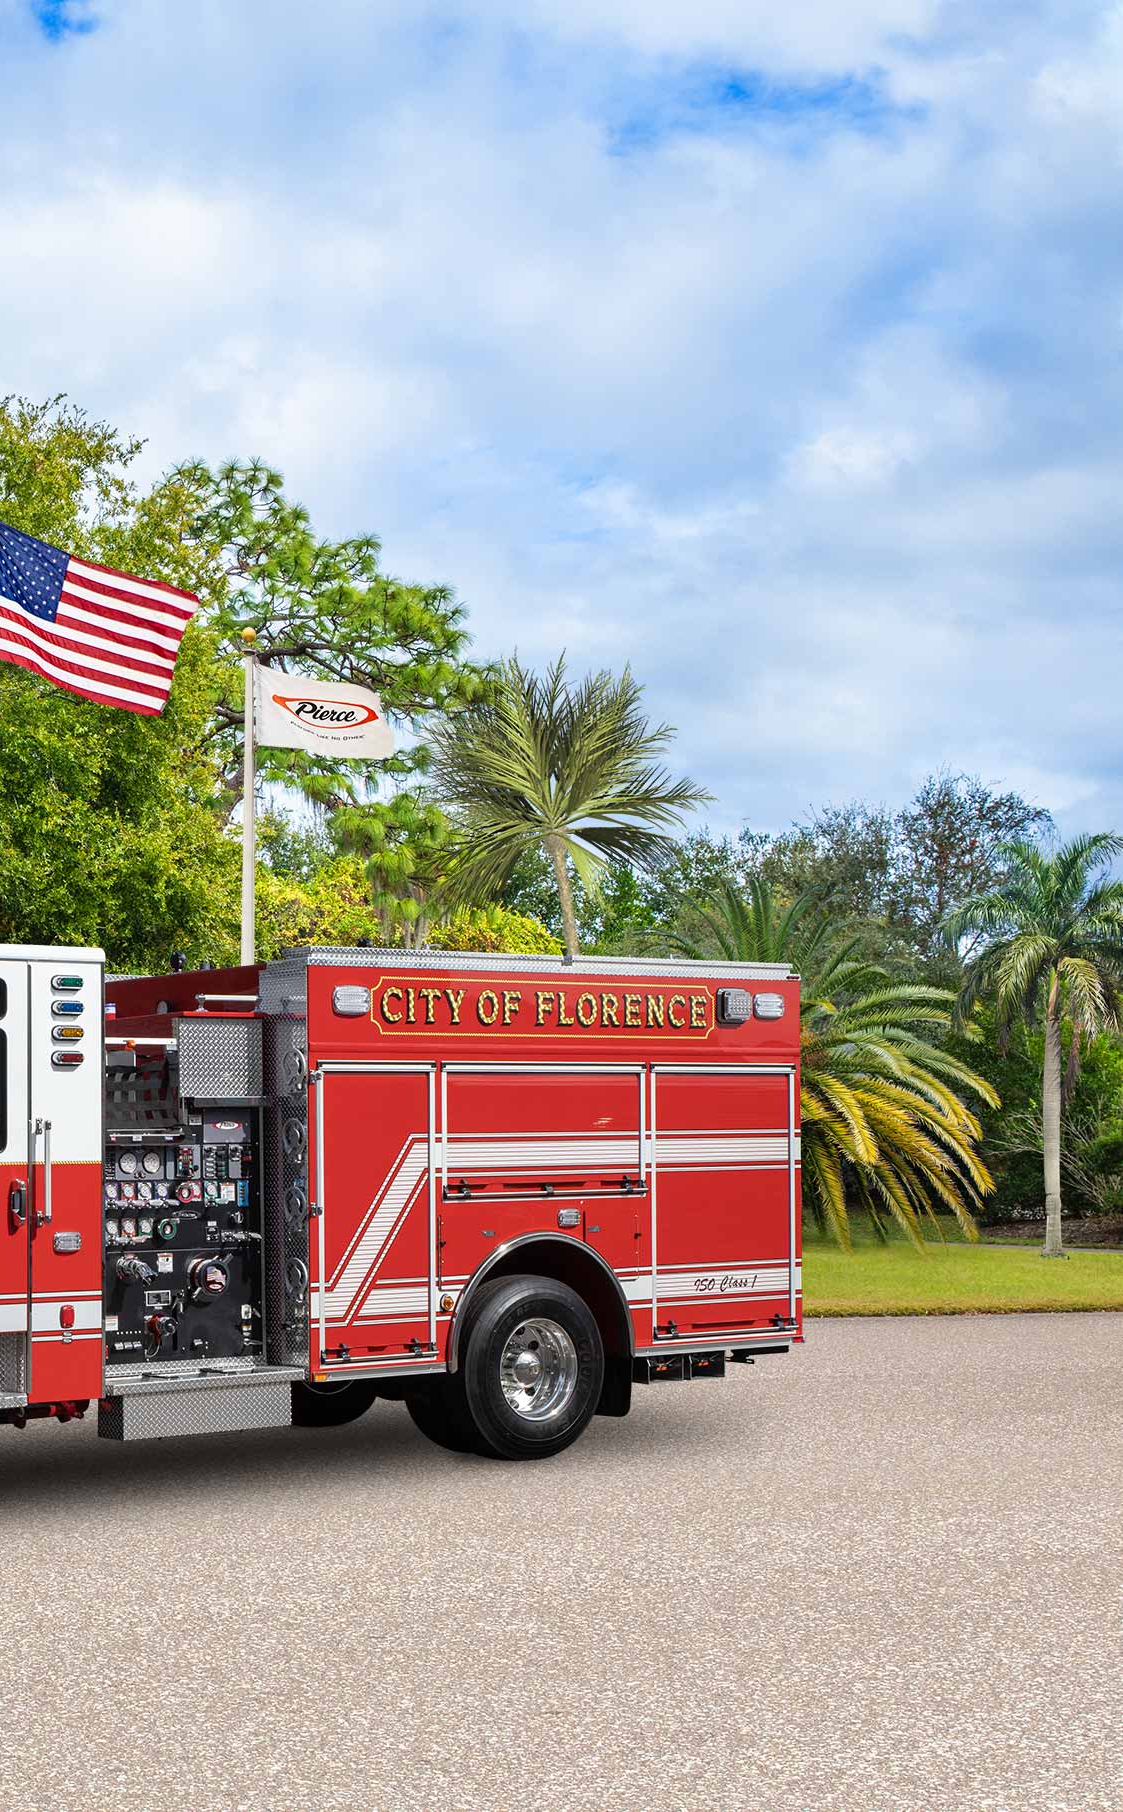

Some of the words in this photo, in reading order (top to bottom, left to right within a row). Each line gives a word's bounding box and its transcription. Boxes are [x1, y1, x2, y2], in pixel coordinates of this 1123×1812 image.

[295, 701, 356, 722] Pierce
[381, 986, 465, 1024] CITY
[477, 989, 522, 1027] OF
[535, 991, 708, 1030] FLORENCE
[693, 1278, 716, 1292] ISO
[719, 1275, 748, 1293] Class
